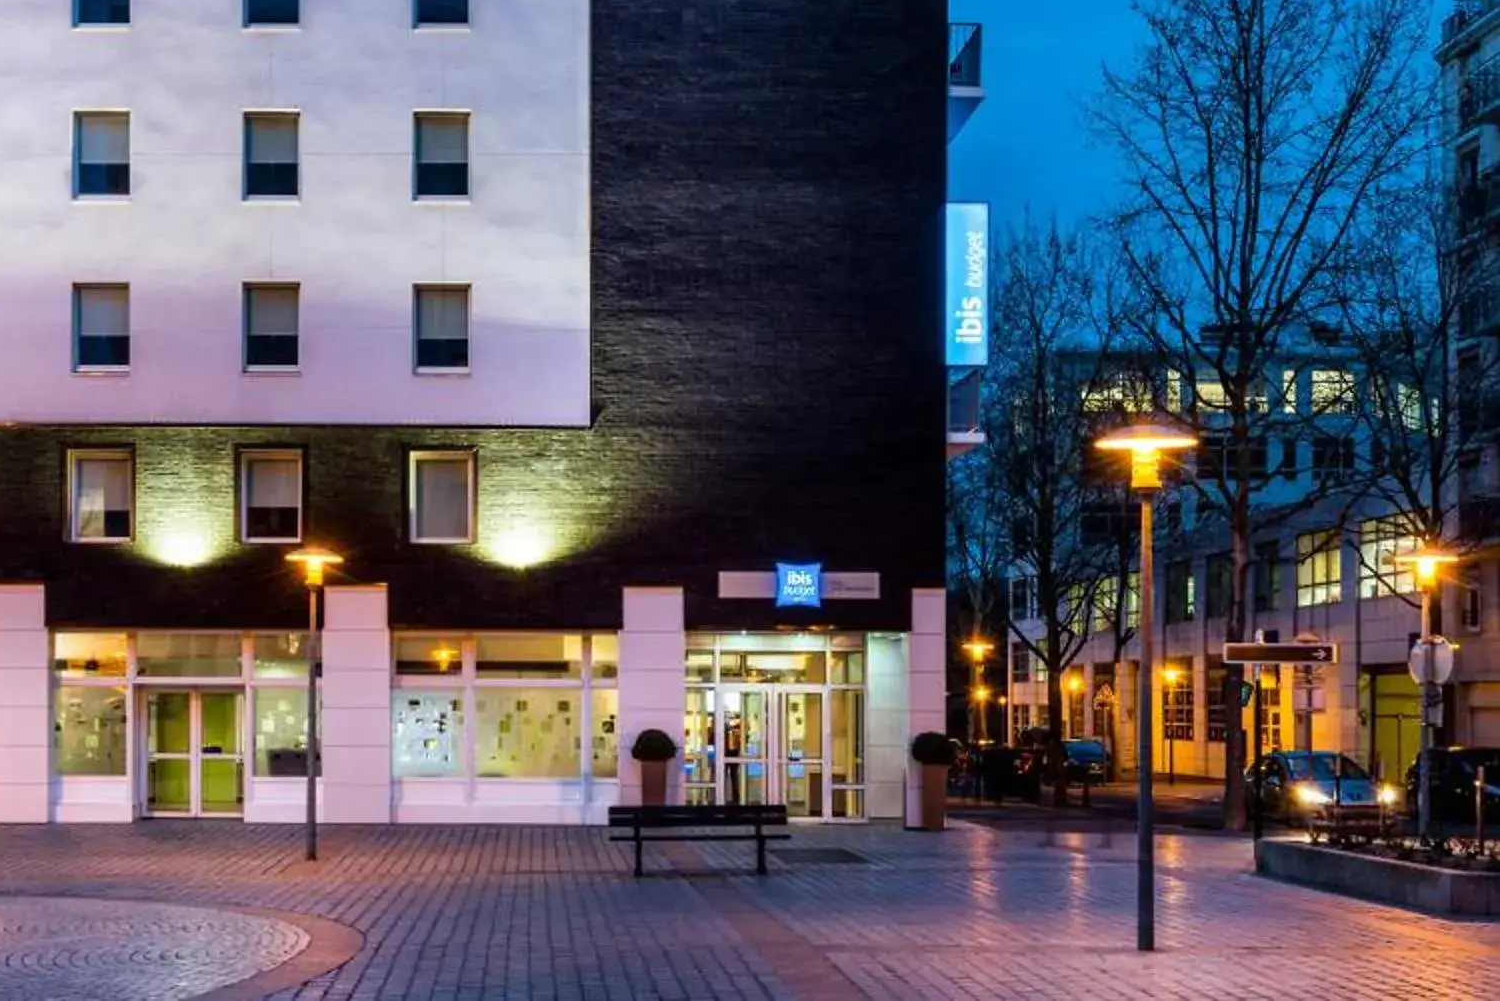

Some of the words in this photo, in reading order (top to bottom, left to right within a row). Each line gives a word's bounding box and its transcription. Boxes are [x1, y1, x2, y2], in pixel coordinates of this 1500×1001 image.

[964, 230, 986, 288] budget
[955, 296, 982, 344] ibis
[787, 570, 813, 585] ibis
